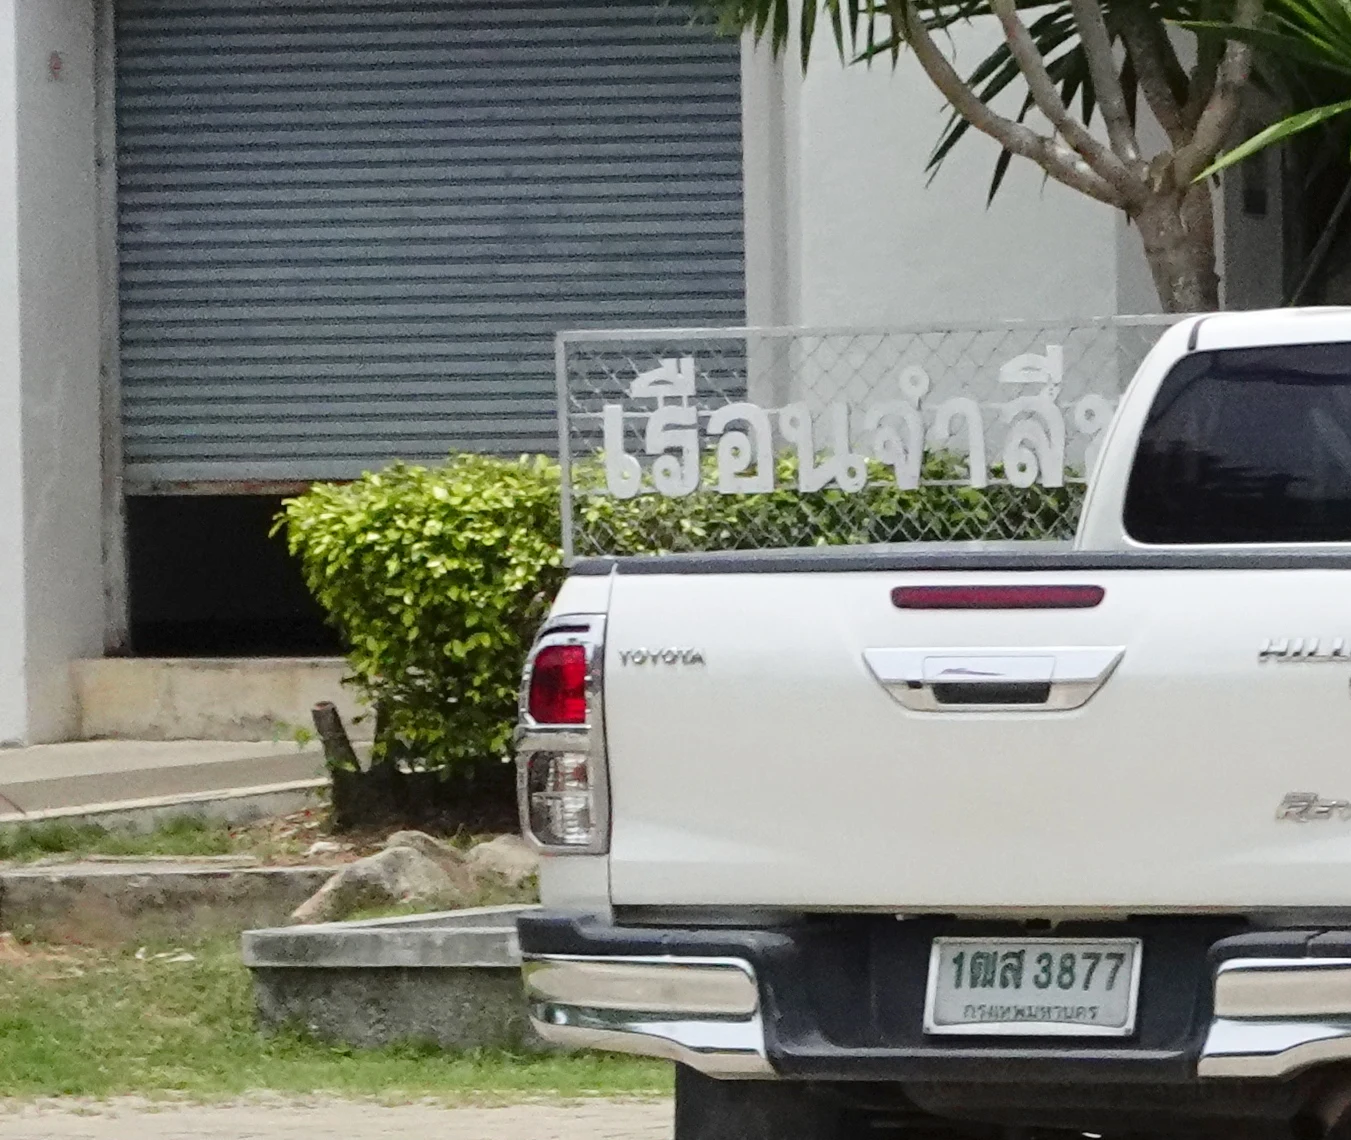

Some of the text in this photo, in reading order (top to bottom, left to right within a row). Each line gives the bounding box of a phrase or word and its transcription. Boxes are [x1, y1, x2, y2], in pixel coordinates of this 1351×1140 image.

[618, 647, 706, 667] TOYOTA
[1033, 952, 1126, 991] 3877
[962, 1003, 1100, 1021] กรุงเทพมหานคร
